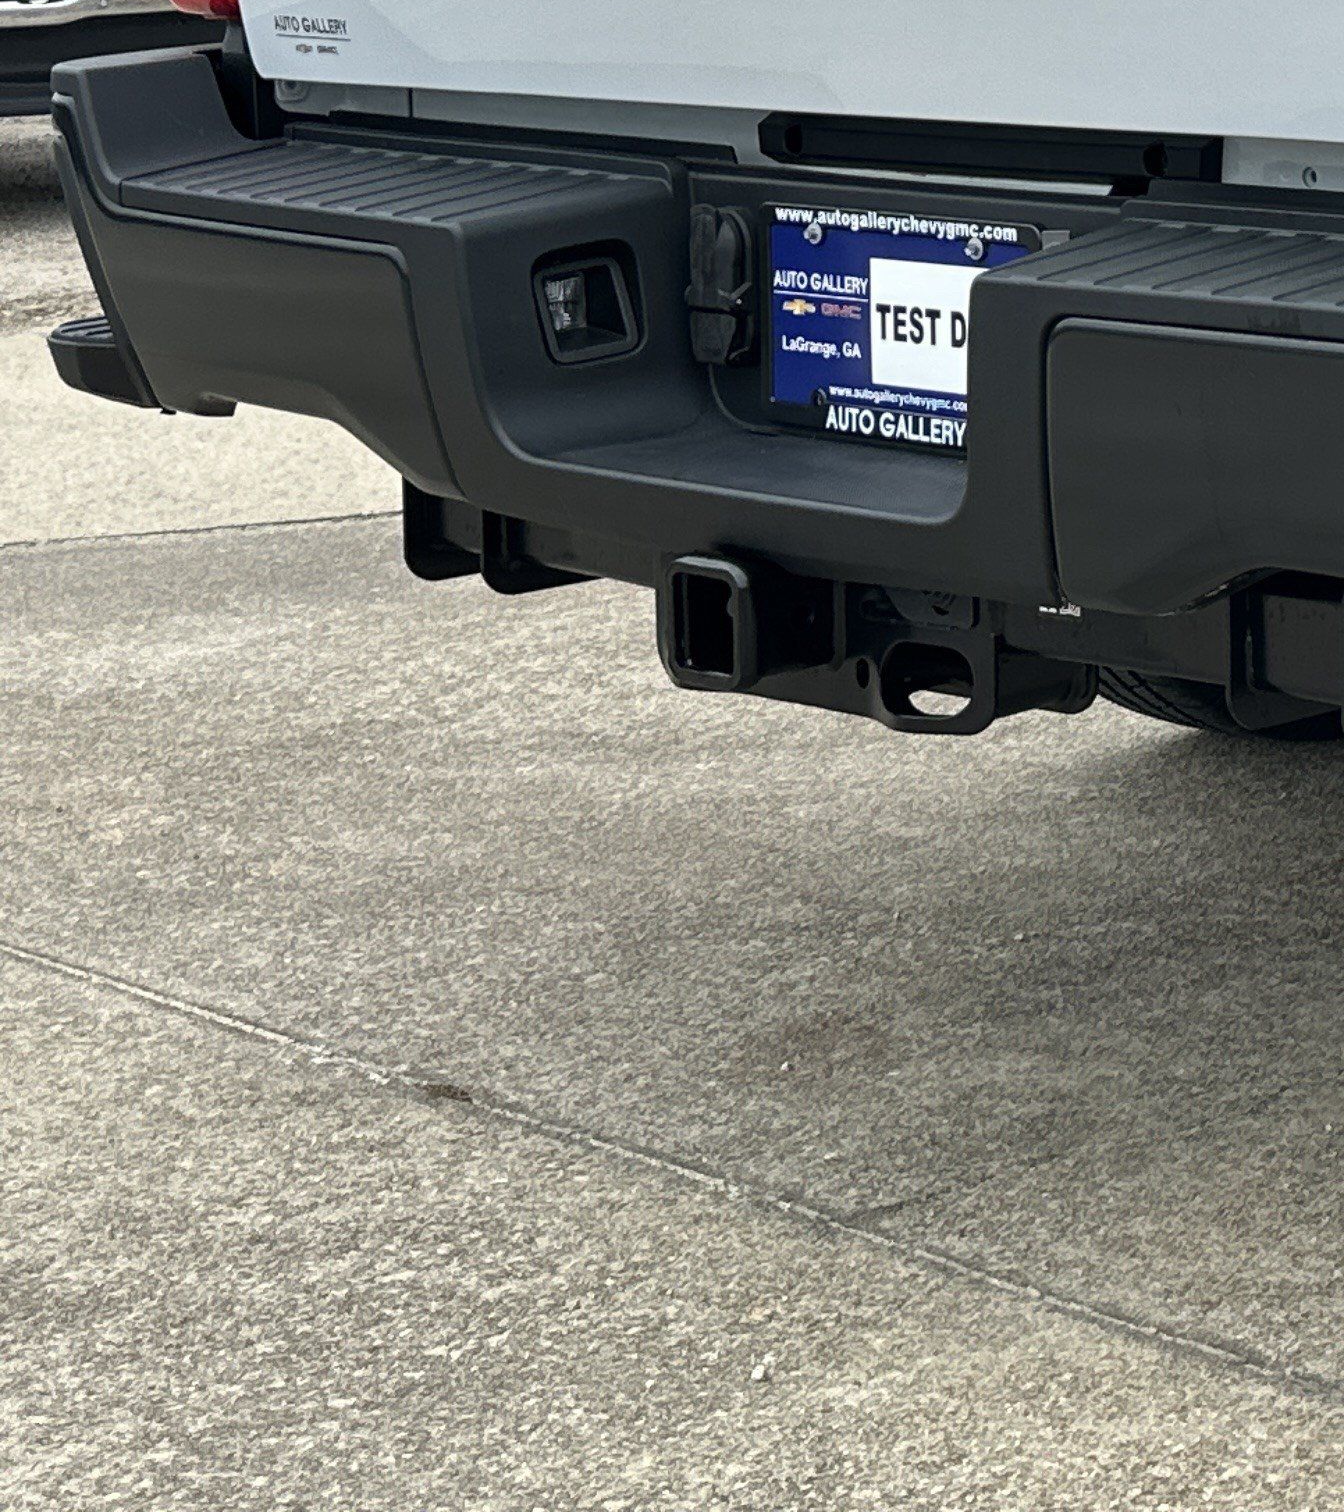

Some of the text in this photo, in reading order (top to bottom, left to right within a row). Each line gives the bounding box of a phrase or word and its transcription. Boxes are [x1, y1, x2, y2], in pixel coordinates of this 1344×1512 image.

[274, 15, 347, 35] AUTO GALLERY
[774, 207, 1018, 243] www.autogallerychevygmc.com
[773, 269, 869, 295] AUTO GALLERY
[876, 303, 941, 345] TEST
[781, 334, 862, 359] LaGrange, GA
[825, 404, 967, 447] AUTO GALLERY
